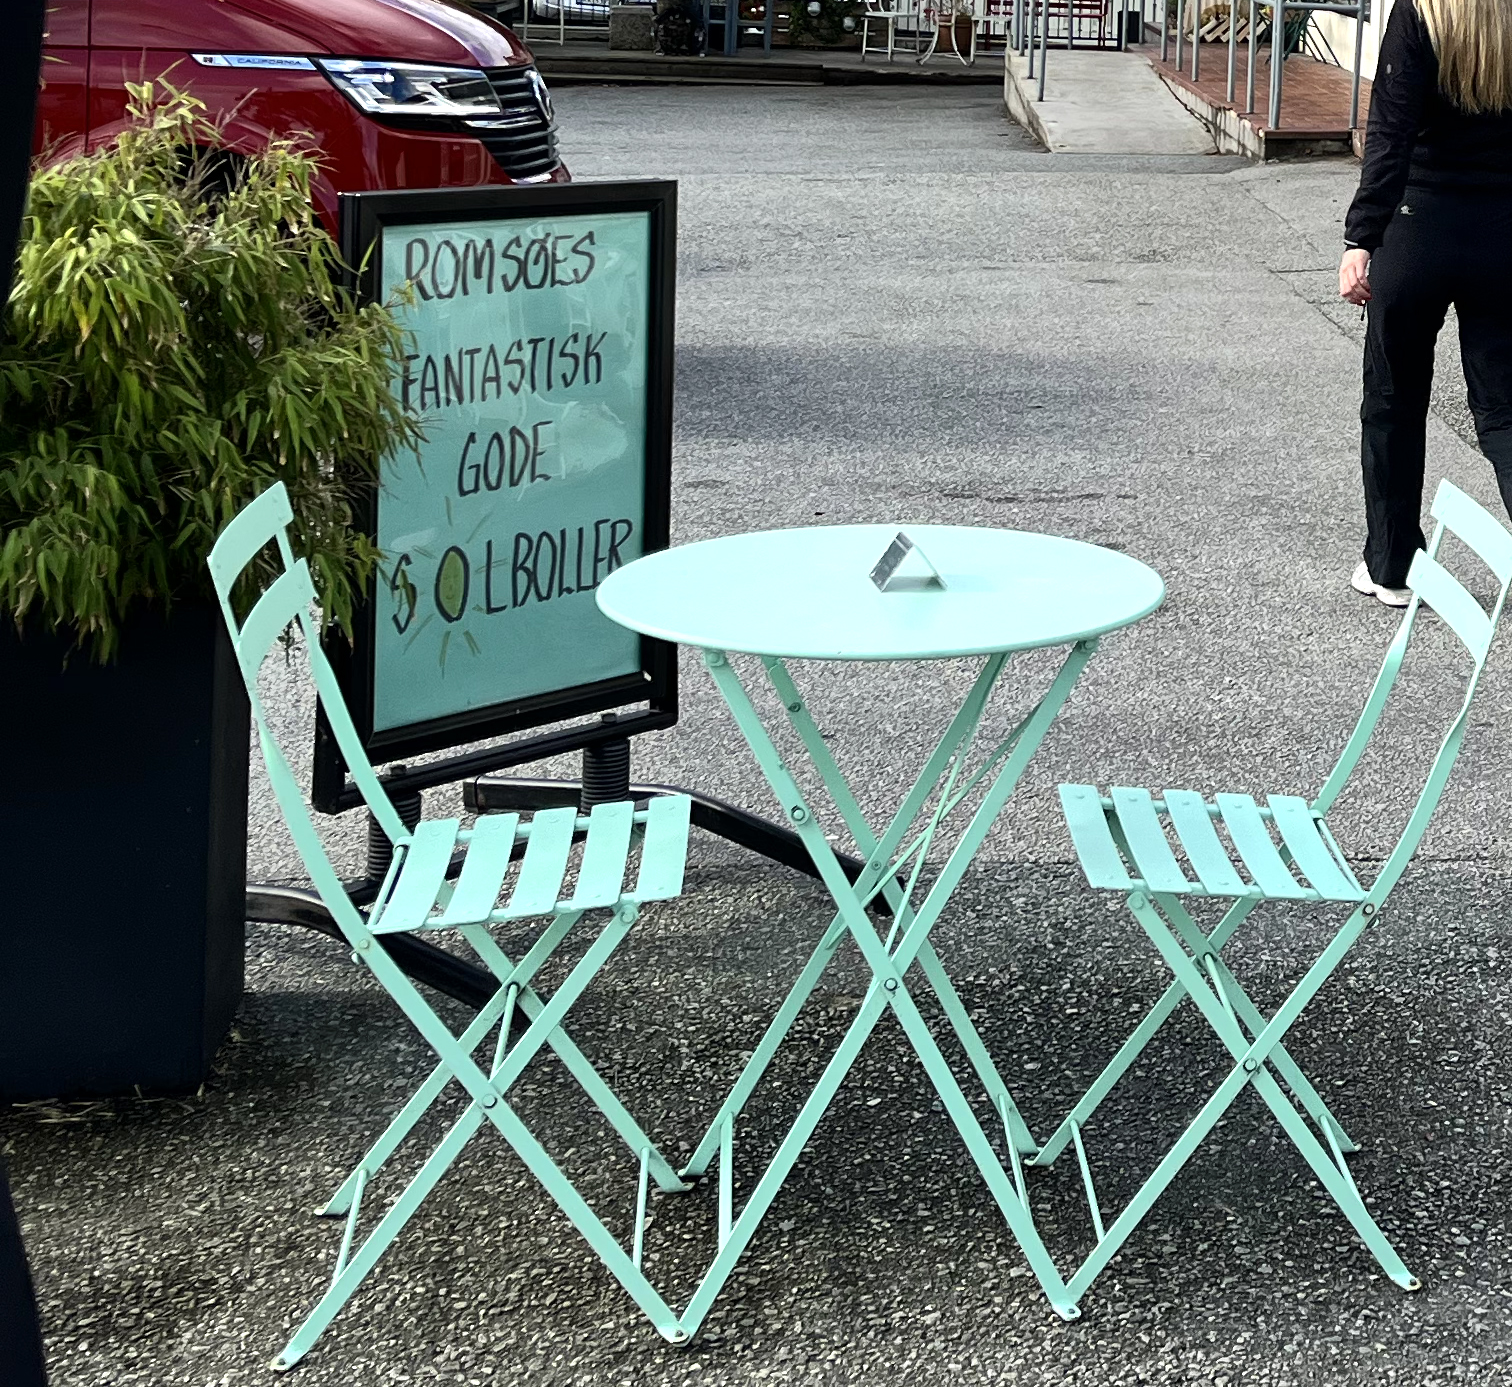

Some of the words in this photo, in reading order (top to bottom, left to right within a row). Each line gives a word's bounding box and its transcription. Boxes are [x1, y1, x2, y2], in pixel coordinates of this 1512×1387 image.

[236, 57, 303, 66] CALIFORNIA
[402, 330, 608, 414] FANTASTISK
[457, 420, 554, 498] GODE
